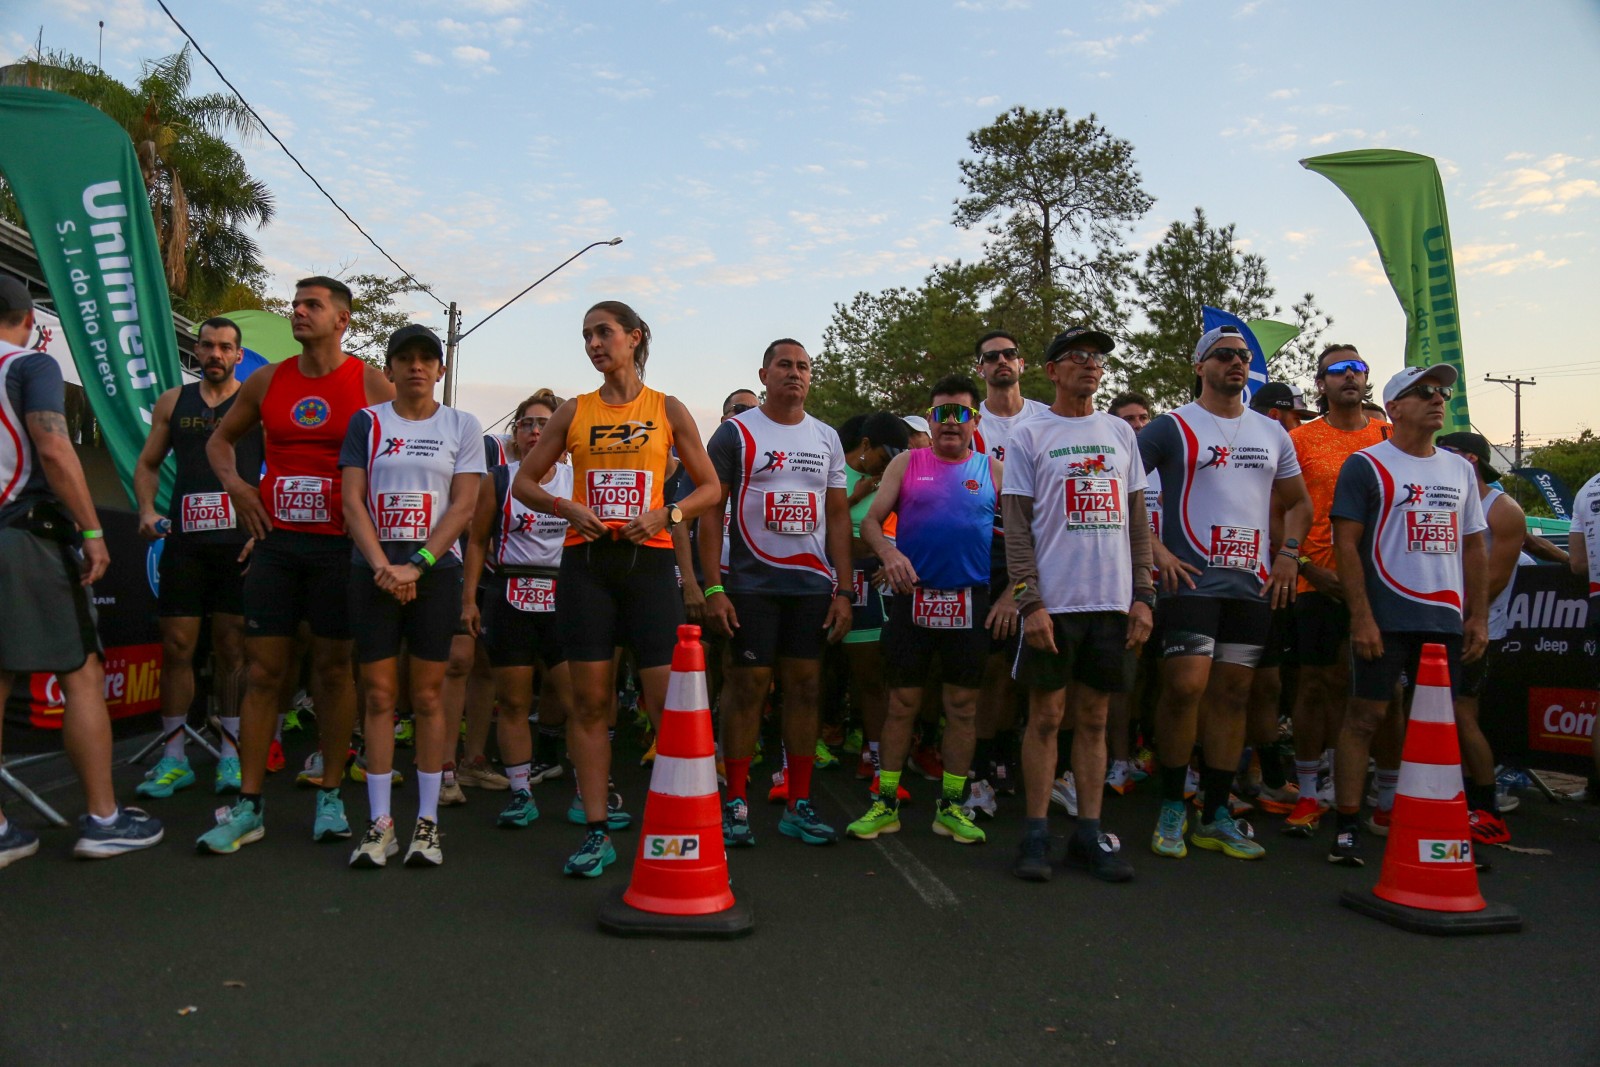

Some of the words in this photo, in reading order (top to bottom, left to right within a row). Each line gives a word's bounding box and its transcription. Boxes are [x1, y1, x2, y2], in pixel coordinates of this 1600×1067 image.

[70, 268, 91, 296] do
[79, 299, 100, 335] Rio
[90, 338, 117, 397] Preto
[796, 452, 821, 460] CORRIDA
[1049, 446, 1071, 459] CORRE
[1101, 445, 1116, 455] TEAM
[788, 459, 824, 467] CAMINHADA
[279, 493, 325, 509] 17498
[591, 488, 640, 504] 17090
[1073, 494, 1115, 510] 17124
[1535, 473, 1565, 515] Saraiva
[186, 507, 226, 521] 17076
[381, 510, 426, 526] 17742
[770, 507, 812, 521] 17292
[1411, 526, 1455, 541] 17555
[1215, 541, 1256, 557] 17295
[513, 589, 556, 603] 17394
[919, 602, 962, 616] 17487
[1534, 637, 1569, 655] Jeep
[650, 838, 698, 857] SAP
[1430, 842, 1470, 860] SAP
